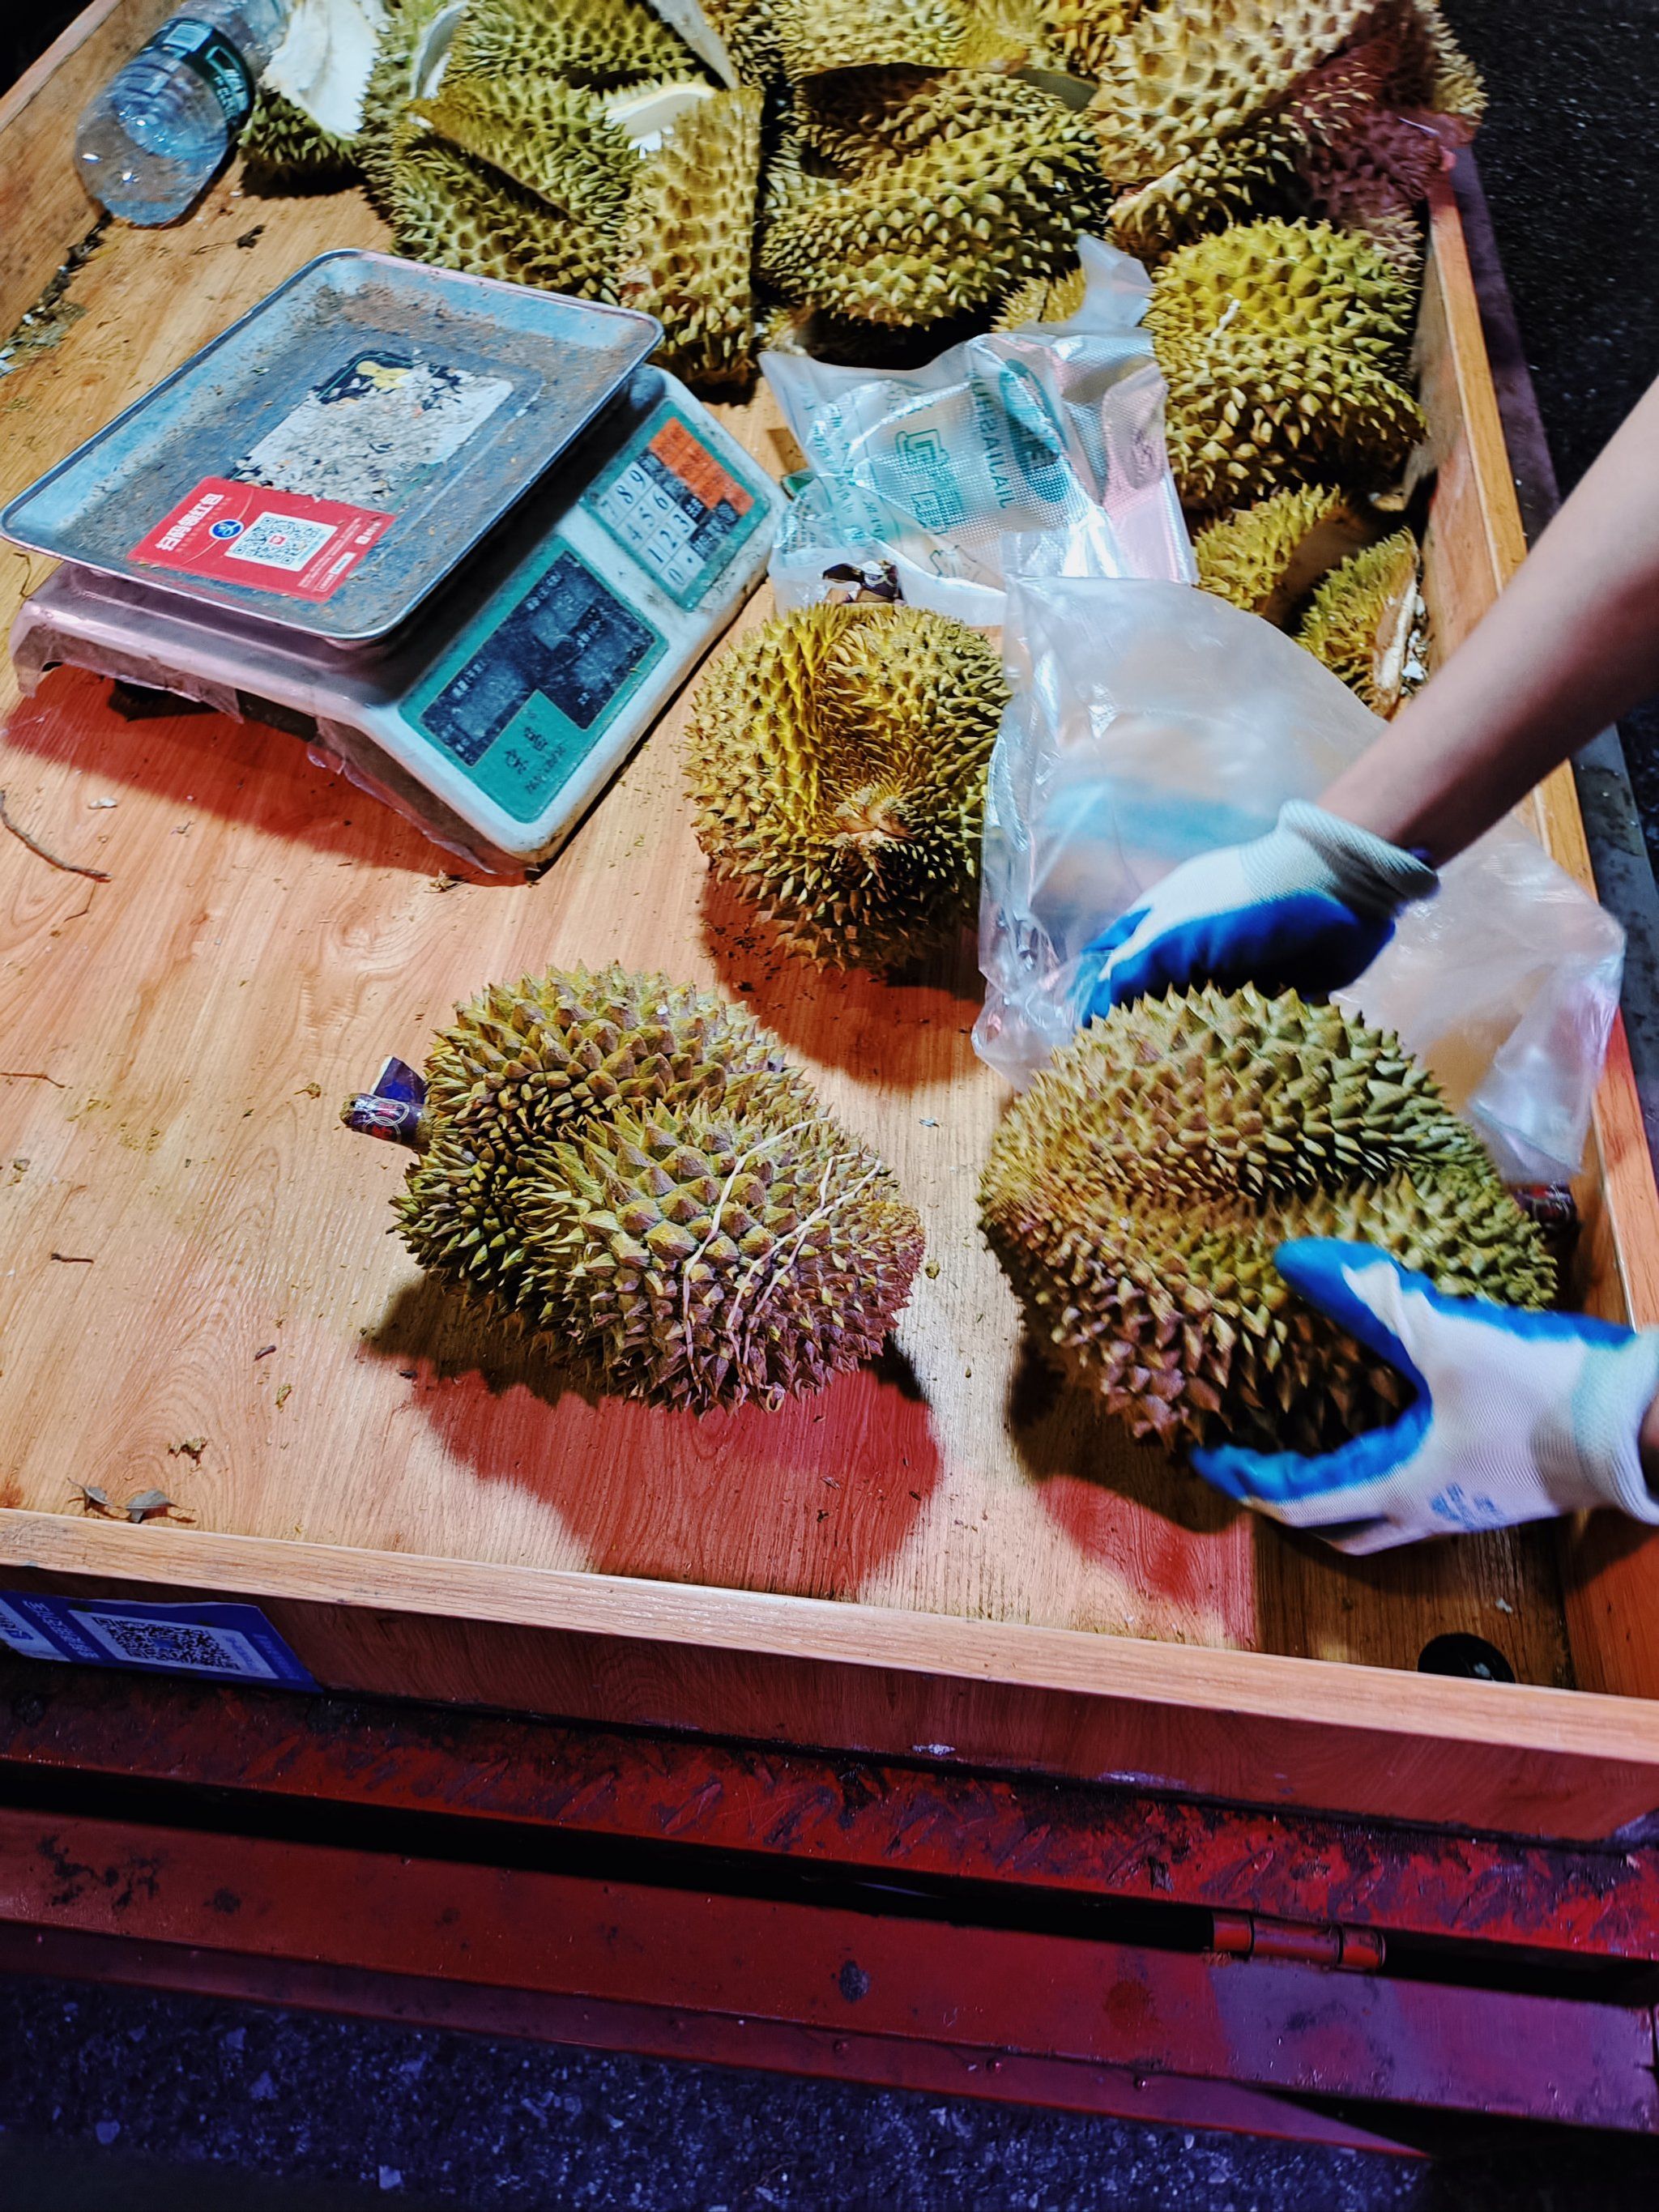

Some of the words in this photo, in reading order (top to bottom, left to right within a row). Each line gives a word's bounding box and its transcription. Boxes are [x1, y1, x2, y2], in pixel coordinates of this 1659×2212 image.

[616, 485, 633, 504] 8
[629, 470, 646, 488] 9
[653, 490, 669, 510] 6
[648, 548, 664, 564] 1
[659, 530, 677, 548] 2
[673, 514, 690, 533] 3
[668, 568, 685, 586] 0
